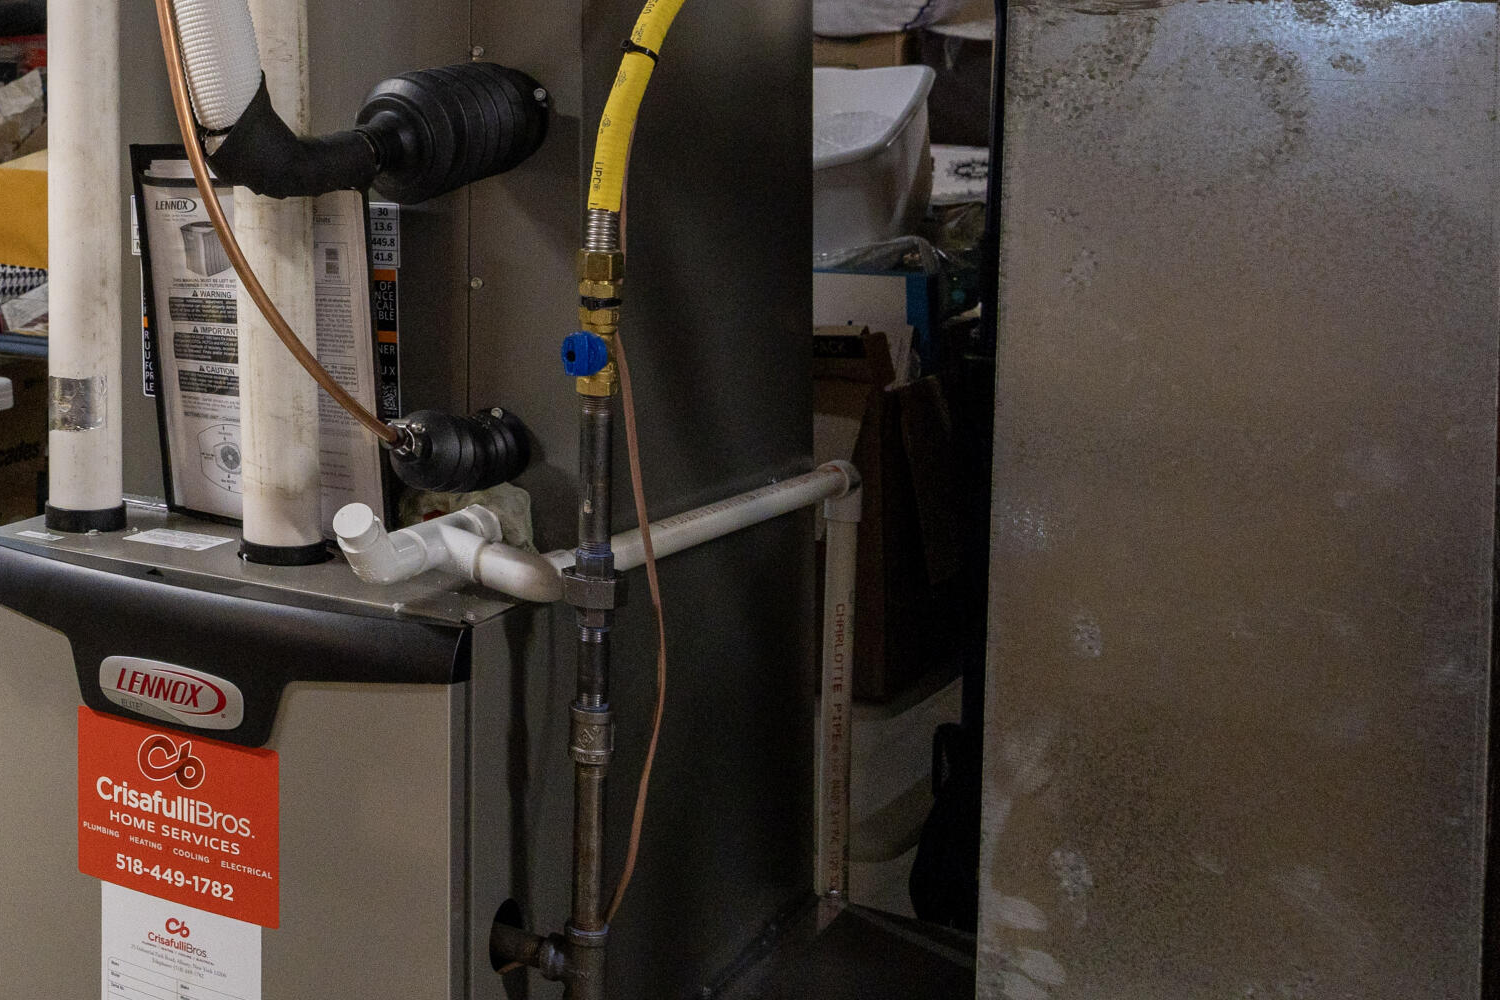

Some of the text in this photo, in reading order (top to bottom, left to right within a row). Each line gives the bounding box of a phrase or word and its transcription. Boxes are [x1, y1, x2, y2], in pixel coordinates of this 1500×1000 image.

[155, 199, 188, 211] LENNOX
[377, 208, 388, 216] 30
[374, 222, 393, 231] 13.6
[374, 252, 393, 262] 41.8
[201, 327, 238, 336] IMPORTANT
[206, 366, 235, 375] CAUTION
[832, 604, 846, 693] CHARLOTTE
[116, 667, 204, 708] LENNOX
[109, 810, 241, 856] HOME SERVICES
[83, 820, 273, 880] PLUMBING HEATING COOLING ELECTRICAL
[116, 853, 234, 902] 518-449-1782
